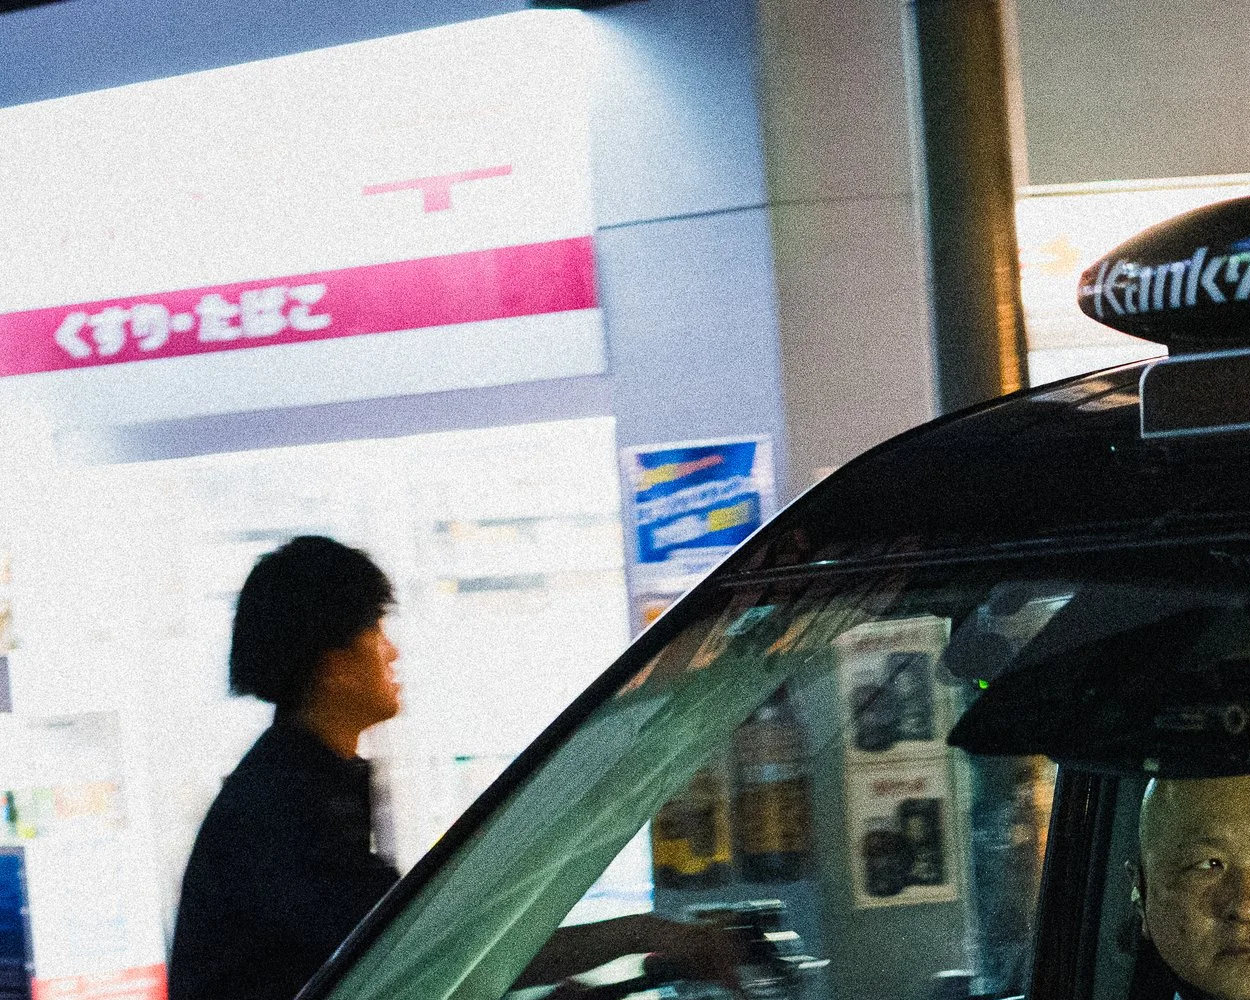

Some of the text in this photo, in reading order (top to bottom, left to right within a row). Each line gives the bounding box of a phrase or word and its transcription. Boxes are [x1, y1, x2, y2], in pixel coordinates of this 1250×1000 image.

[54, 283, 332, 359] くすり・たばこ
